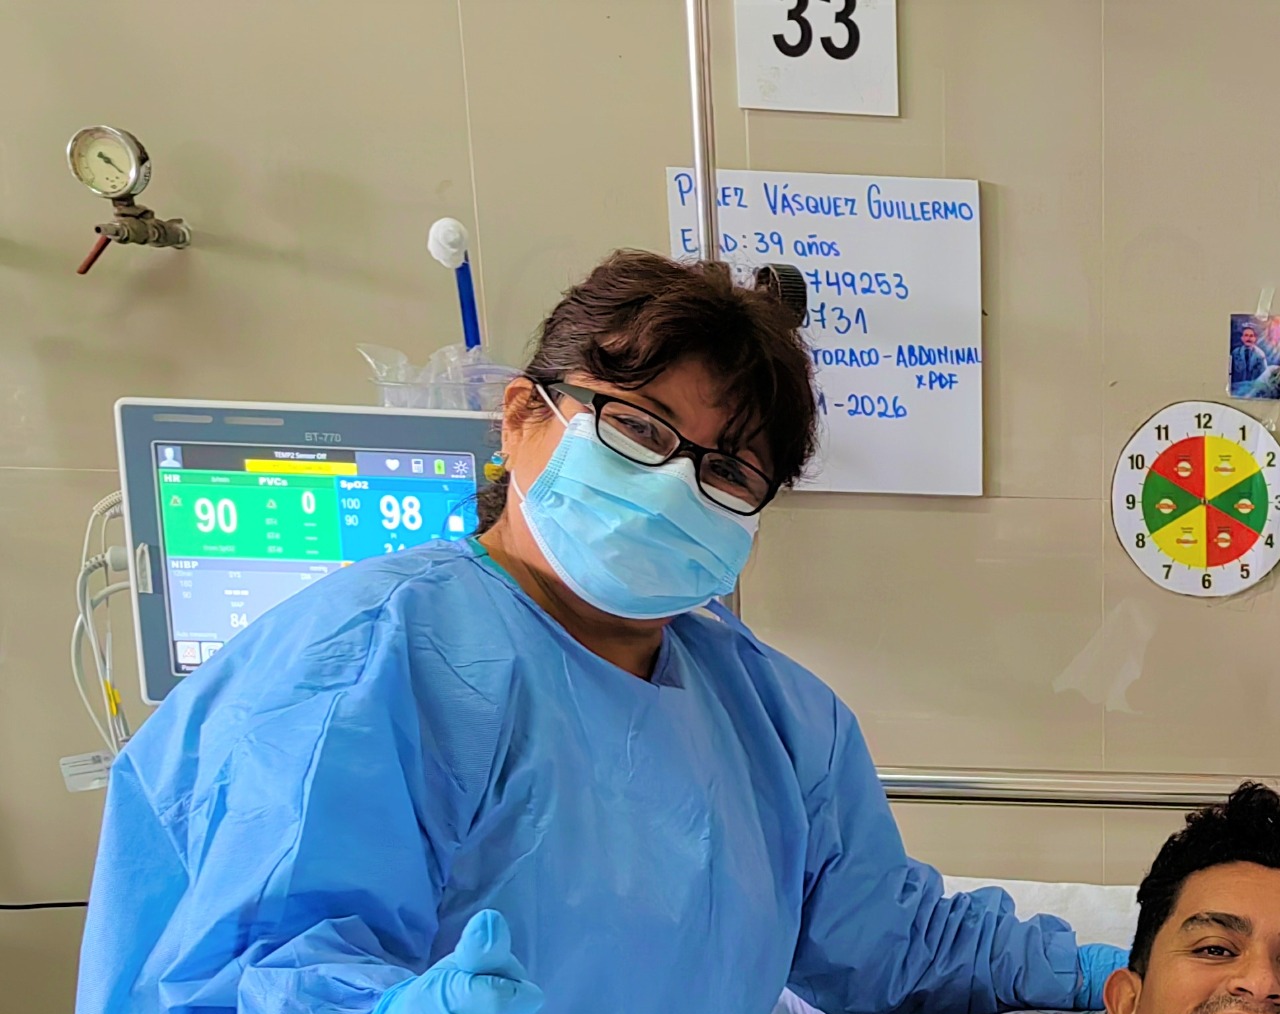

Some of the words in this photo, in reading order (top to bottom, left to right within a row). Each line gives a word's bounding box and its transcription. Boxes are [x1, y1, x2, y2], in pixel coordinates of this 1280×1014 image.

[674, 173, 748, 208] PEZ
[763, 182, 858, 217] VÁSQUEZ
[867, 184, 974, 221] GUILLERMO
[754, 231, 784, 255] 39
[793, 234, 841, 257] años
[1194, 413, 1212, 429] 12
[1155, 425, 1170, 441] 11
[1239, 425, 1246, 441] 1
[1128, 454, 1145, 470] 10
[1266, 452, 1276, 467] 2
[163, 474, 181, 483] HR
[258, 477, 288, 486] PVCs
[302, 491, 316, 514] 0
[341, 498, 361, 510] 100
[1126, 495, 1136, 510] 9
[194, 497, 237, 533] 90
[379, 494, 423, 530] 98
[345, 515, 359, 526] 90
[1136, 533, 1146, 549] 8
[1264, 534, 1274, 549] 4
[171, 561, 199, 569] NIBP
[1162, 564, 1172, 579] 7
[1240, 564, 1250, 579] 5
[1201, 574, 1212, 589] 6
[230, 613, 248, 628] 84
